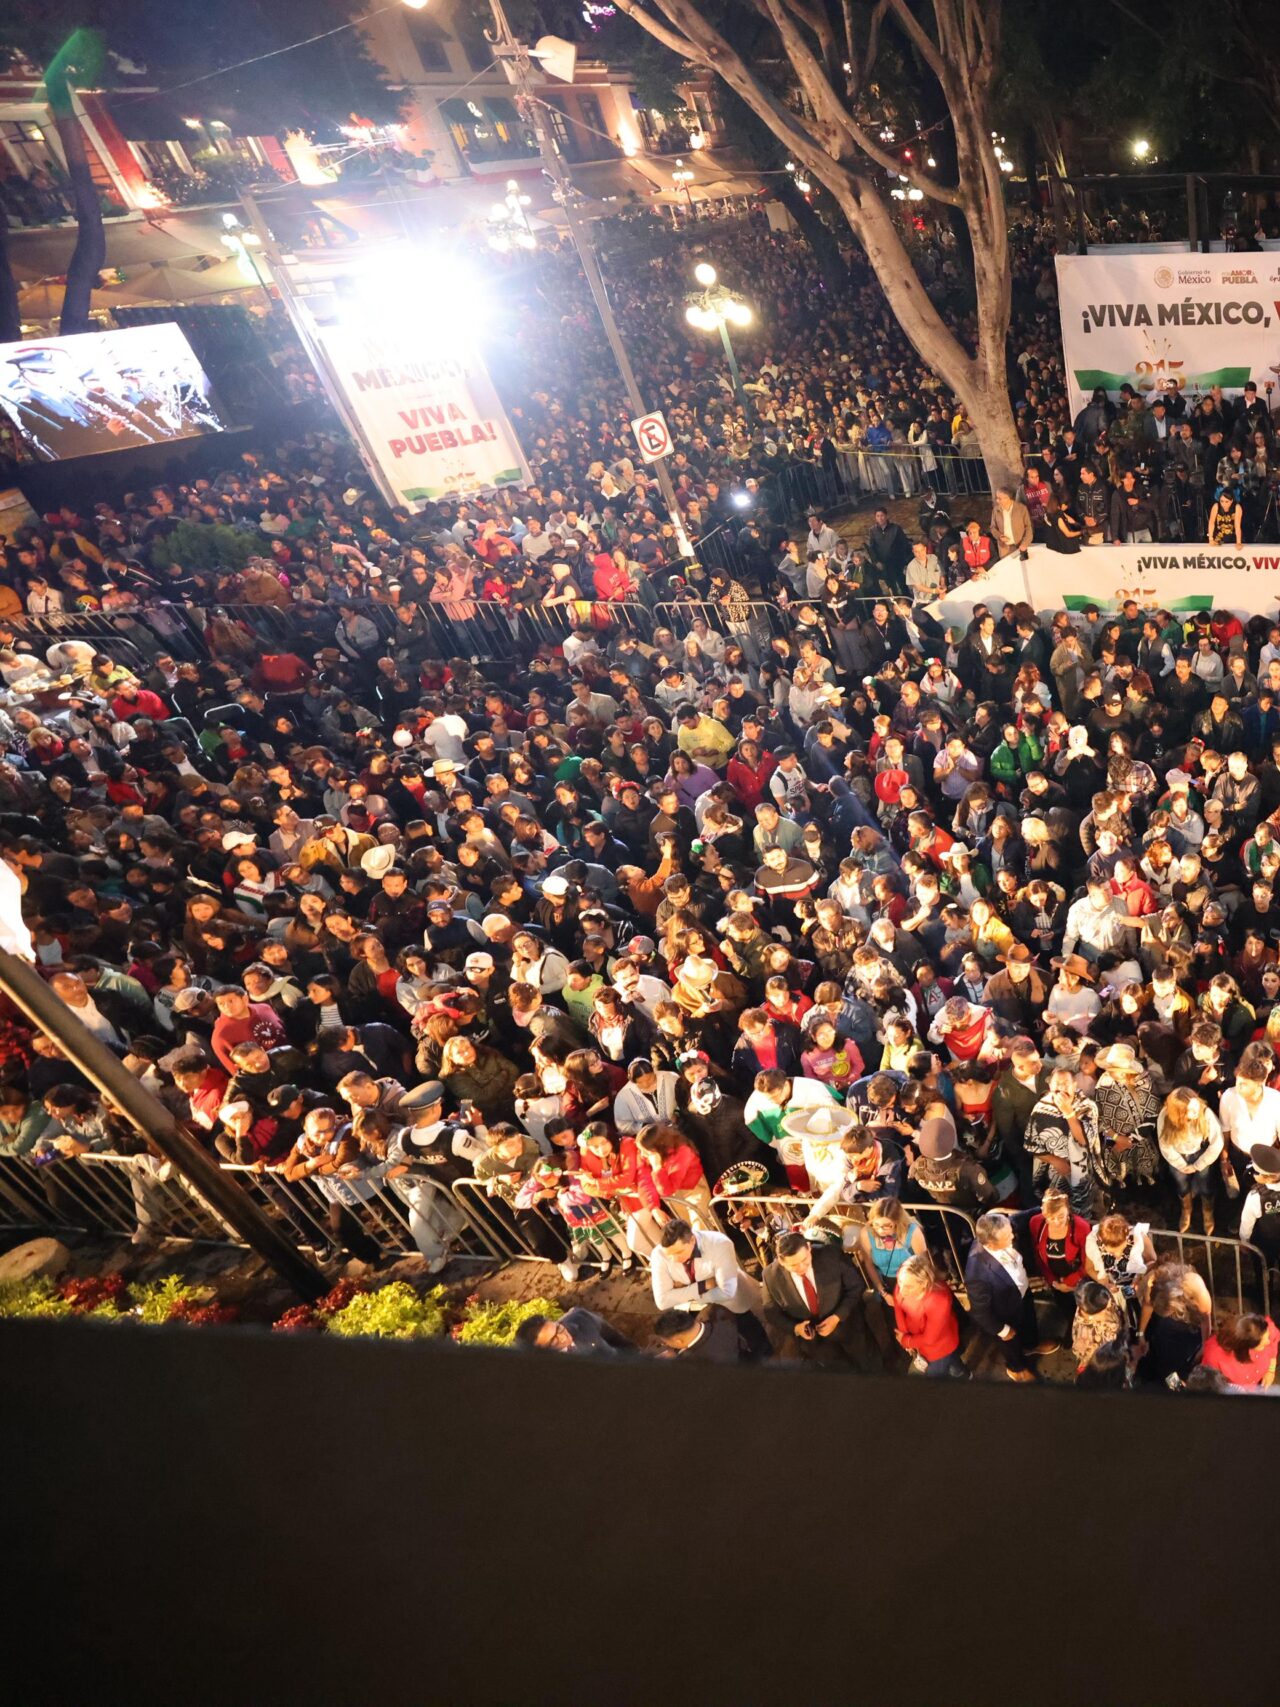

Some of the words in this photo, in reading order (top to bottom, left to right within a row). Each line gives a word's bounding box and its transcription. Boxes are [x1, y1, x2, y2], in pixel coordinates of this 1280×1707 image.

[1178, 274, 1212, 285] México
[1222, 275, 1258, 285] PUEBLA
[1082, 304, 1153, 333] ¡VIVA
[1157, 297, 1271, 328] MÉXICO,
[397, 402, 467, 430] VIVA
[387, 422, 498, 459] PUEBLA!
[1137, 556, 1180, 573] ¡VIVA
[1183, 553, 1251, 572] MÉXICO,
